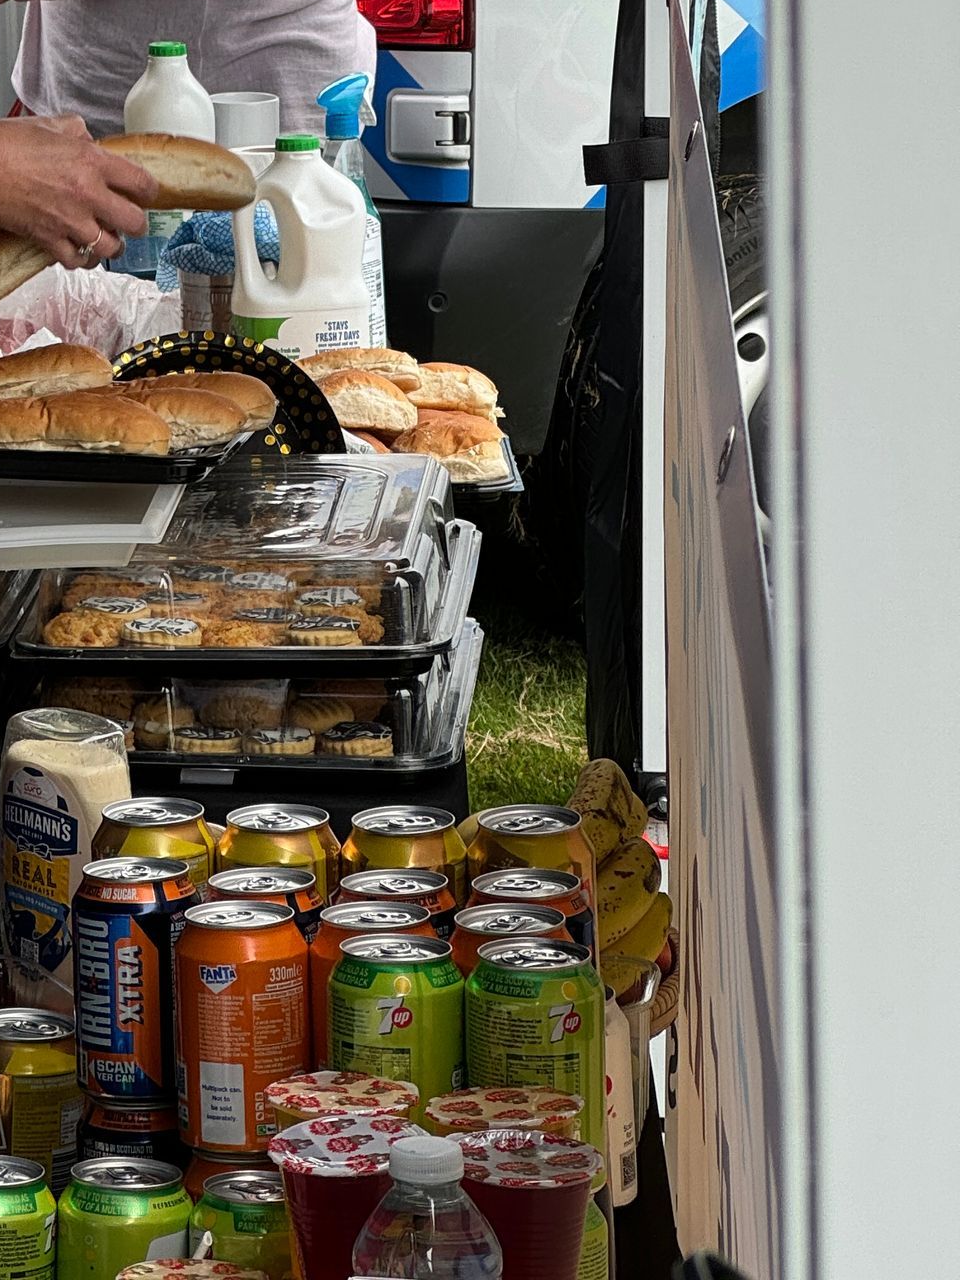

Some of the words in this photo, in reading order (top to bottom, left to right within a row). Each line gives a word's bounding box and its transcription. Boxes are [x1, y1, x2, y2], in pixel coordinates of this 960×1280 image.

[315, 332, 337, 342] FRESH
[338, 332, 342, 341] 7
[343, 331, 360, 341] DAYS
[5, 803, 72, 842] HELLMANN'S
[12, 856, 57, 889] REAL
[11, 877, 55, 897] MAYONNAISE
[101, 887, 113, 899] NO
[200, 965, 237, 981] FANTA
[117, 945, 140, 1025] XTRA
[495, 984, 537, 997] MULTIPACK
[96, 1060, 136, 1074] SCAN
[97, 1072, 113, 1082] YER
[115, 1073, 135, 1083] CAN
[202, 1084, 227, 1093] Multipack
[219, 1104, 232, 1112] sold
[207, 1114, 236, 1122] separately
[116, 1144, 145, 1154] SCOTLAND
[146, 1145, 153, 1155] TO
[20, 1193, 29, 1202] AS
[85, 1202, 94, 1211] OF
